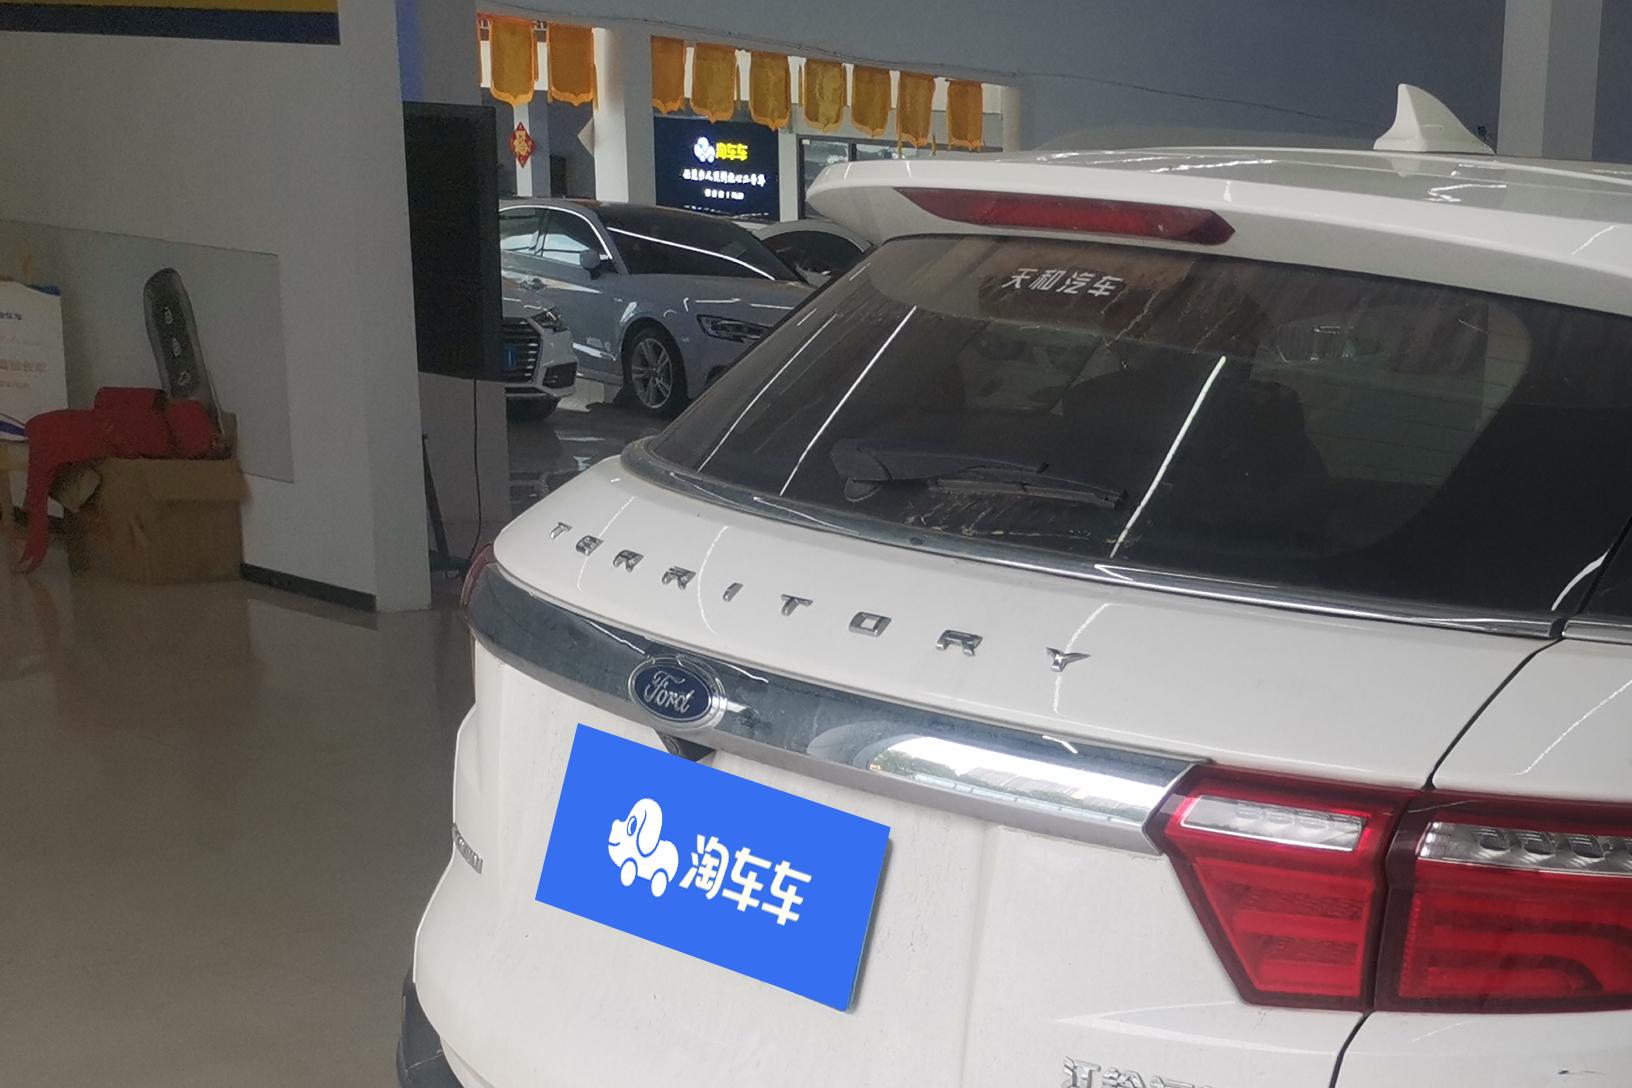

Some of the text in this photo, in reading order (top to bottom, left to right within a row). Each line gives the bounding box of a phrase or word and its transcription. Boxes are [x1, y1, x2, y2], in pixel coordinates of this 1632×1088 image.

[1002, 267, 1123, 297] 天和汽车
[550, 521, 1091, 672] TERRITORY
[643, 670, 696, 713] Ford
